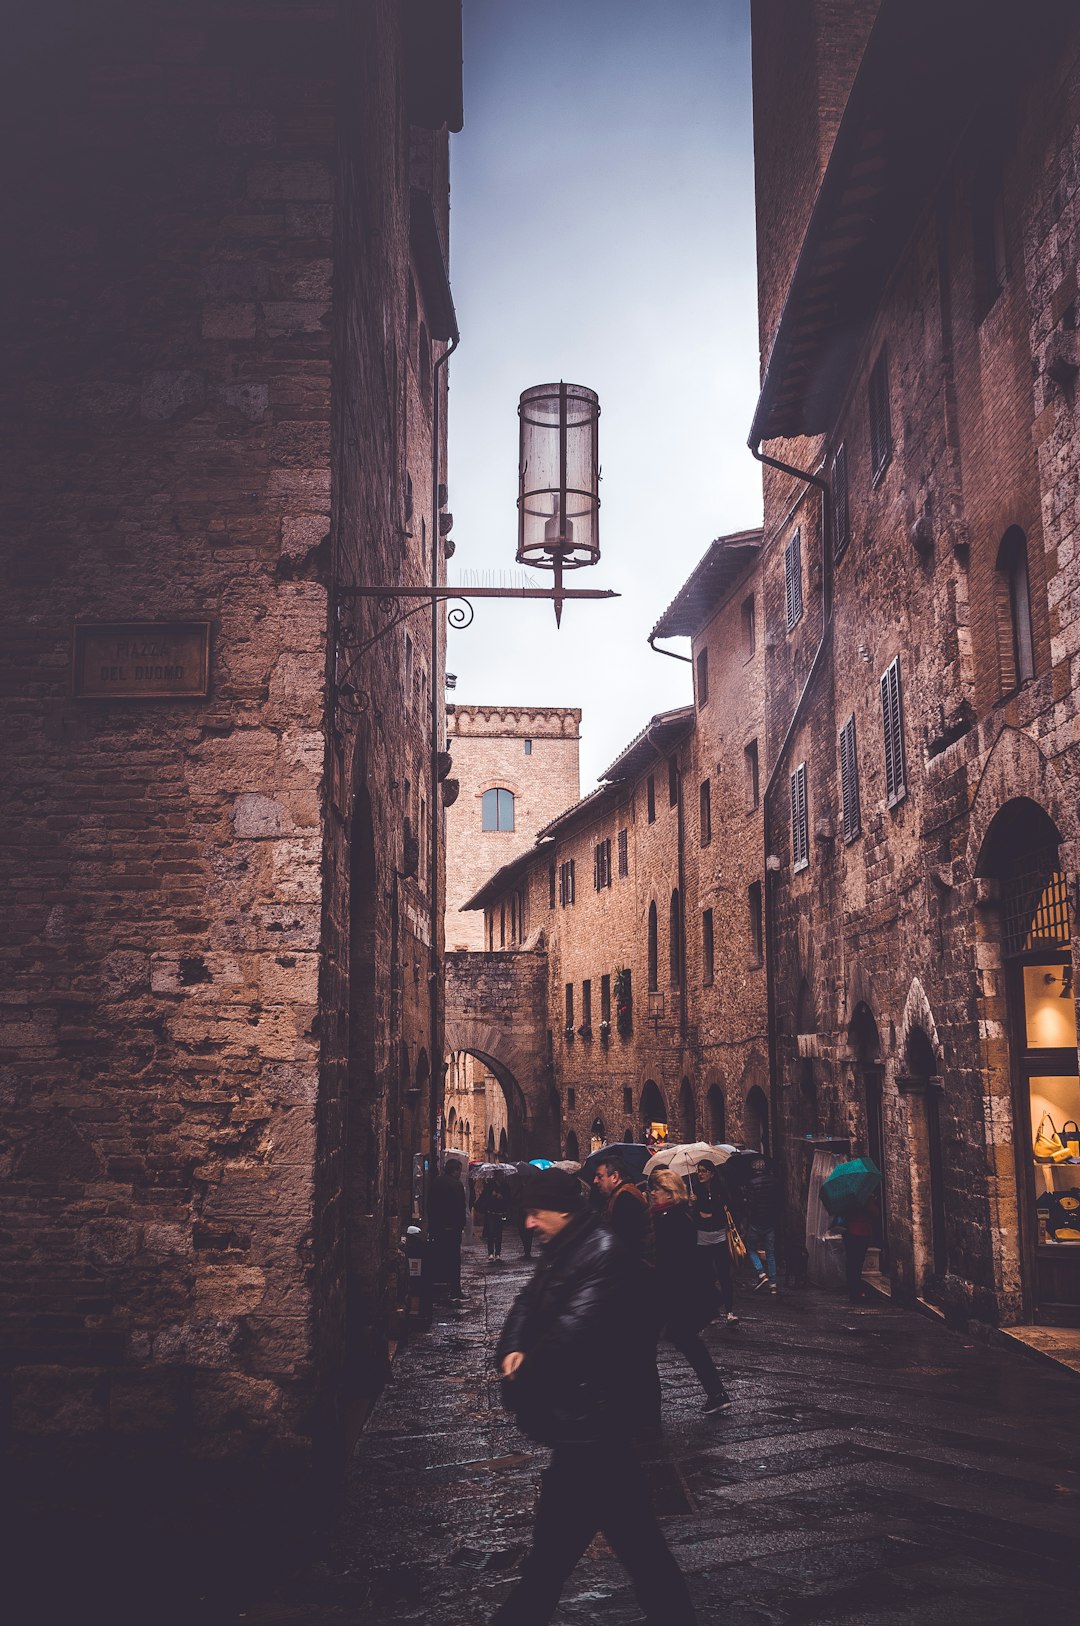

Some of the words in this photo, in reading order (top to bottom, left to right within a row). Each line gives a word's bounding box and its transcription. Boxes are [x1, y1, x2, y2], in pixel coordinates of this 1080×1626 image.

[116, 641, 168, 657] PIAZZA
[100, 666, 127, 681] DEL
[135, 665, 184, 680] DUOMO
